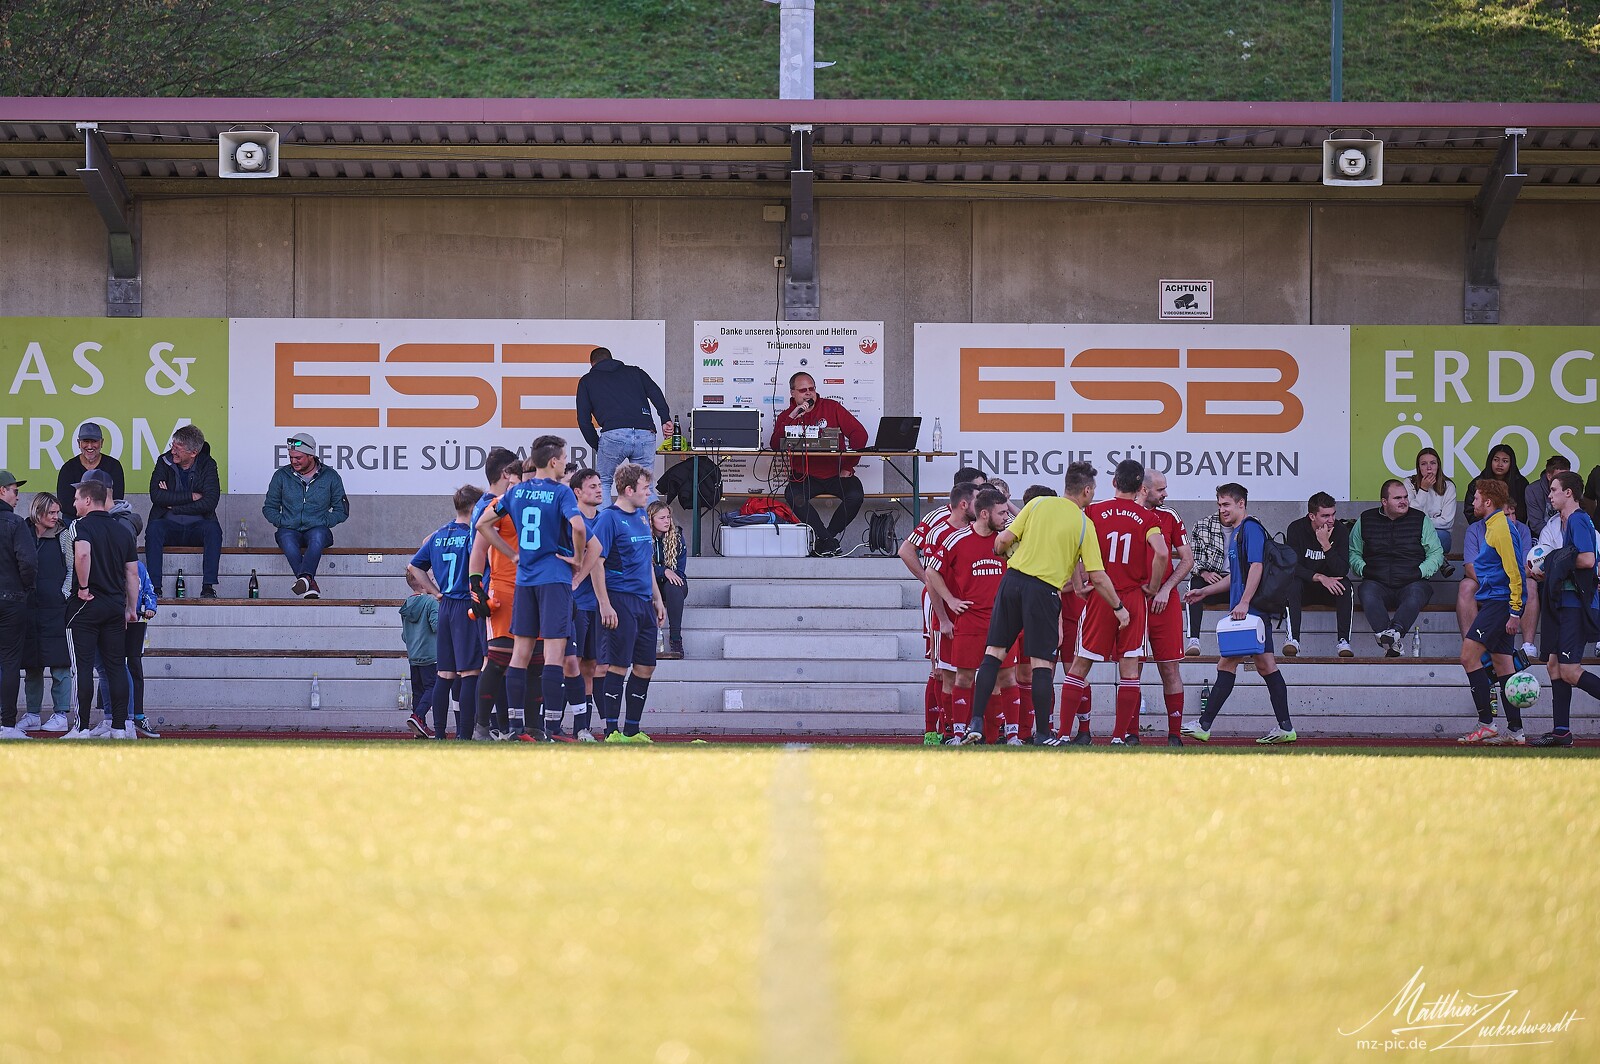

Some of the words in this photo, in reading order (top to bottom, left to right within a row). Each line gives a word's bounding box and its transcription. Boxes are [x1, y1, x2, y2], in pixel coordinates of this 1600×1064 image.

[1165, 284, 1208, 292] ACHTUNG
[720, 327, 743, 336] Danke
[745, 328, 774, 336] unseren
[776, 327, 814, 337] Sponsoren
[816, 327, 829, 336] und
[831, 327, 858, 336] Helfern
[767, 341, 811, 350] Tribünenbau
[144, 341, 197, 396] &
[703, 358, 724, 367] WWK
[275, 342, 605, 429] ESB
[1385, 350, 1598, 404] ERDG
[960, 347, 1304, 434] ESB
[1382, 412, 1600, 478] ÖKOS
[273, 444, 409, 471] EERGIE
[515, 489, 525, 498] SV
[526, 490, 554, 500] TACHING
[1101, 509, 1113, 519] SV
[1116, 509, 1143, 525] Laufen
[520, 506, 541, 551] 8
[435, 538, 442, 547] SV
[443, 536, 466, 547] TACHING
[1106, 531, 1132, 564] 11
[442, 552, 457, 593] 7
[972, 559, 1002, 568] GASTHAUS
[972, 568, 1003, 576] GREIMEL
